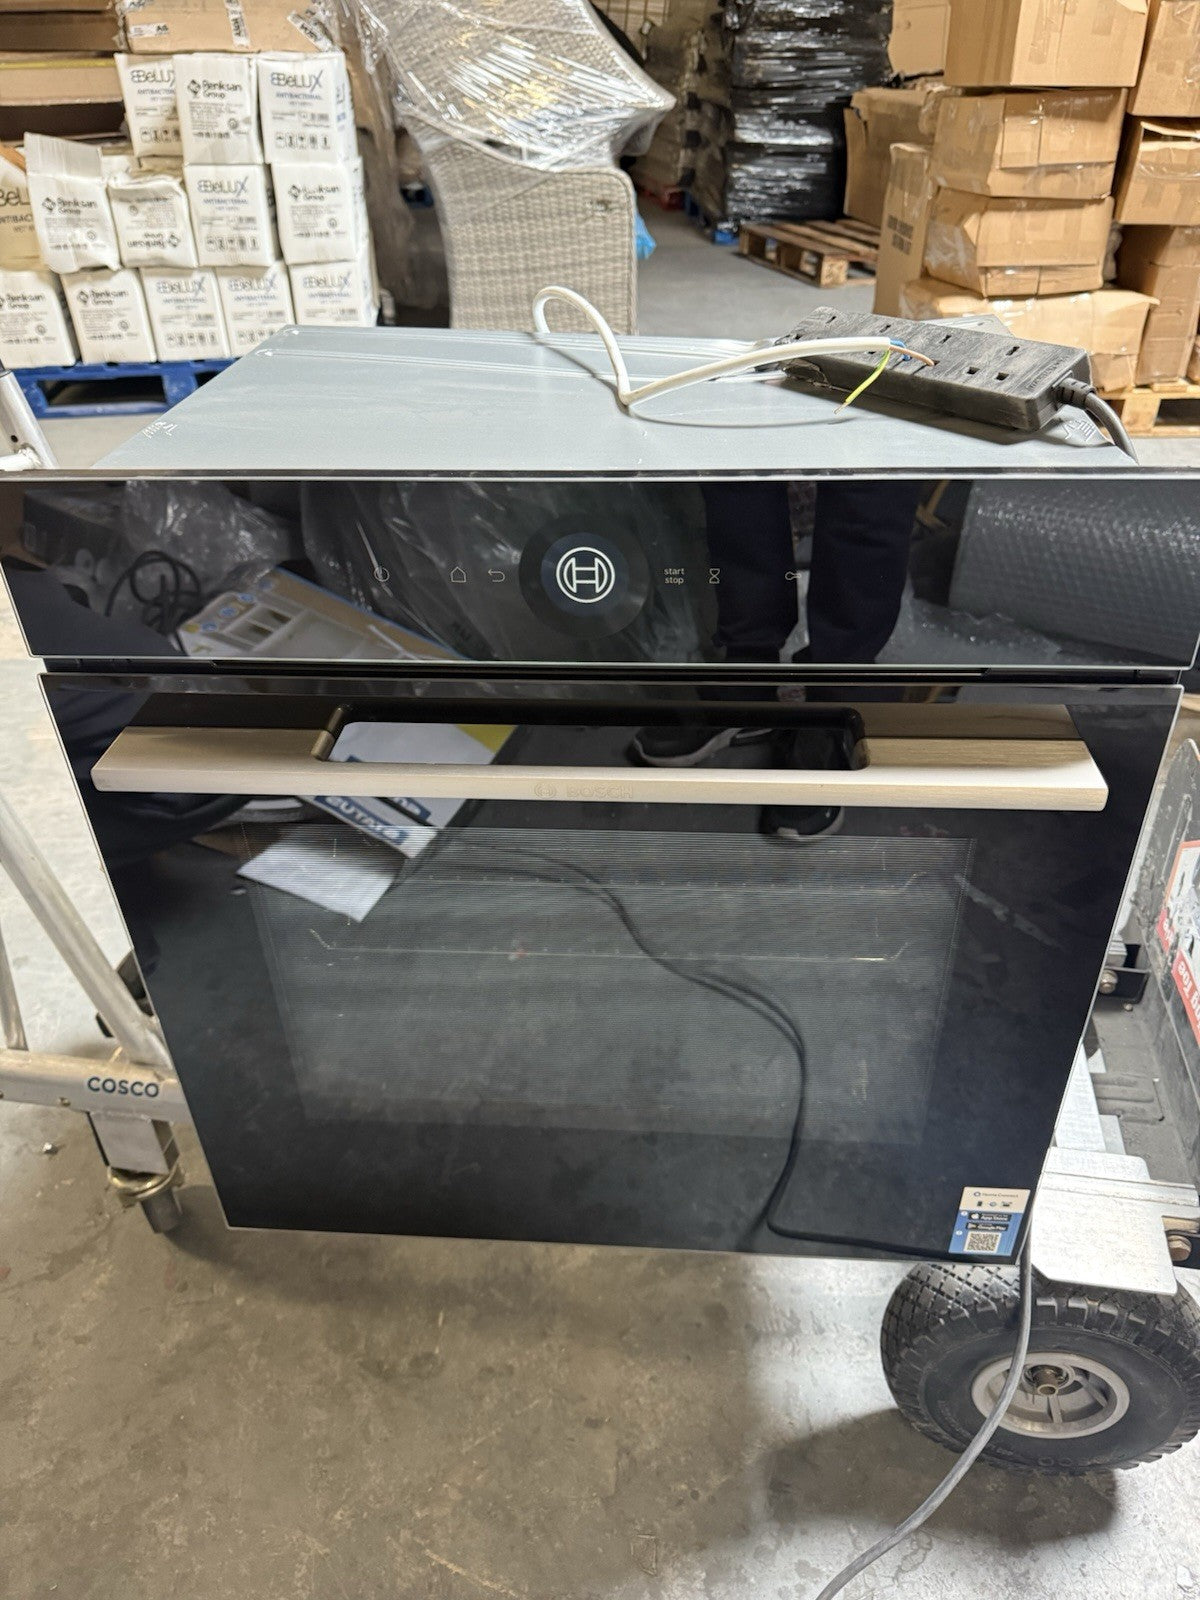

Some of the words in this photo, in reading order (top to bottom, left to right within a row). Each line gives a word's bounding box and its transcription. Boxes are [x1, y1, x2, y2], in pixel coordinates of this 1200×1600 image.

[664, 568, 685, 576] start
[664, 577, 684, 585] stop
[87, 1077, 159, 1098] COSCO
